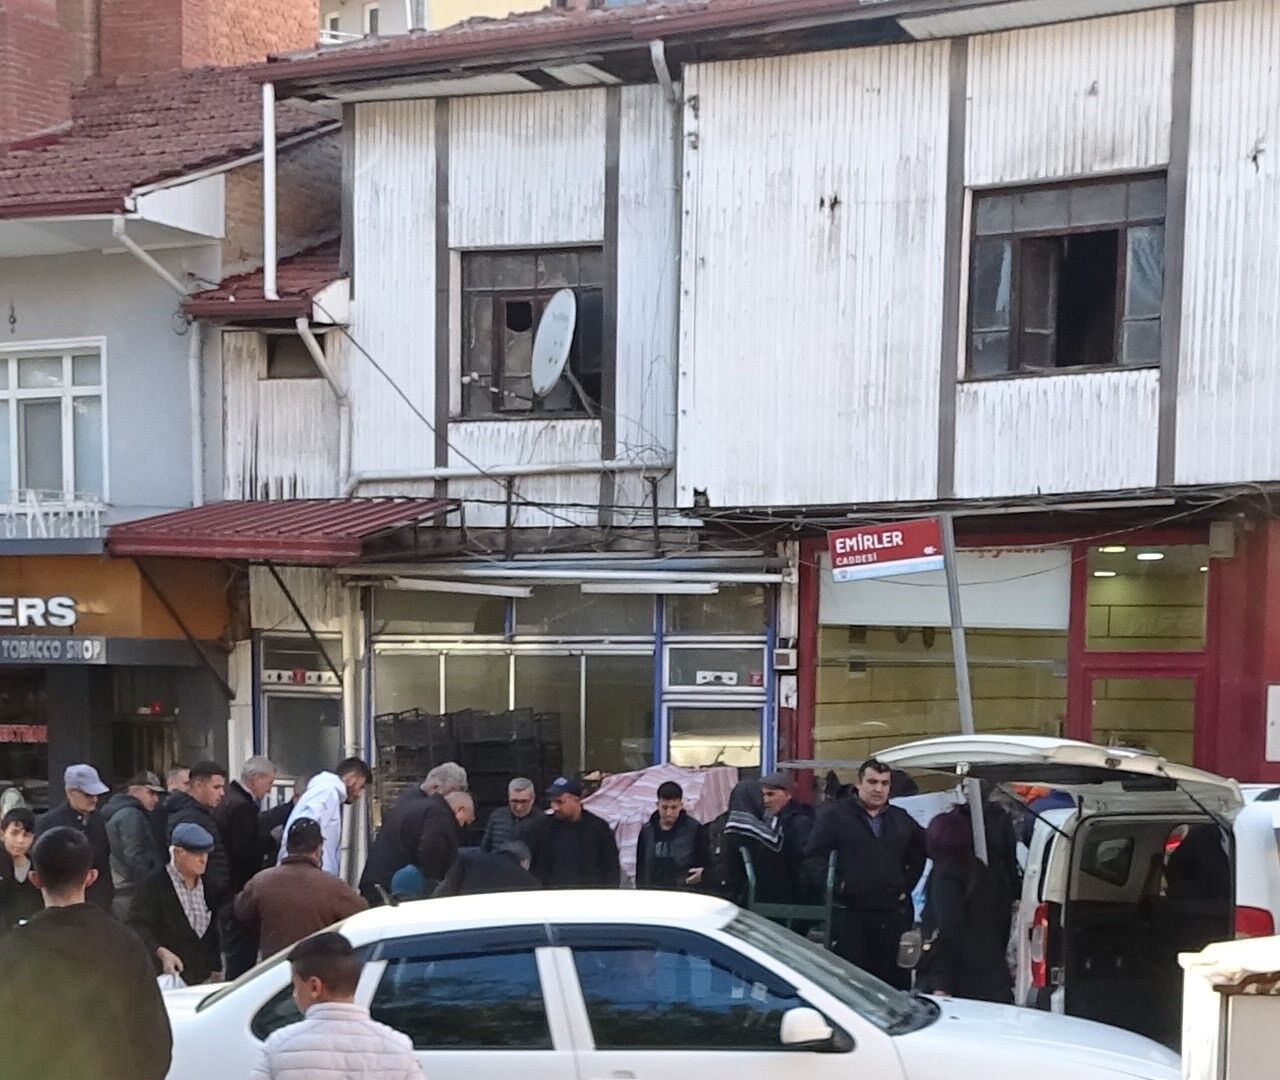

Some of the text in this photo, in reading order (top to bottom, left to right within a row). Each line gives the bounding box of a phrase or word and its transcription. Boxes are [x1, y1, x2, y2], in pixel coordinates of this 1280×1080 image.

[835, 531, 903, 553] EMİRLER
[835, 552, 878, 566] CADDESİ
[3, 639, 100, 660] TOBACCO SHOP
